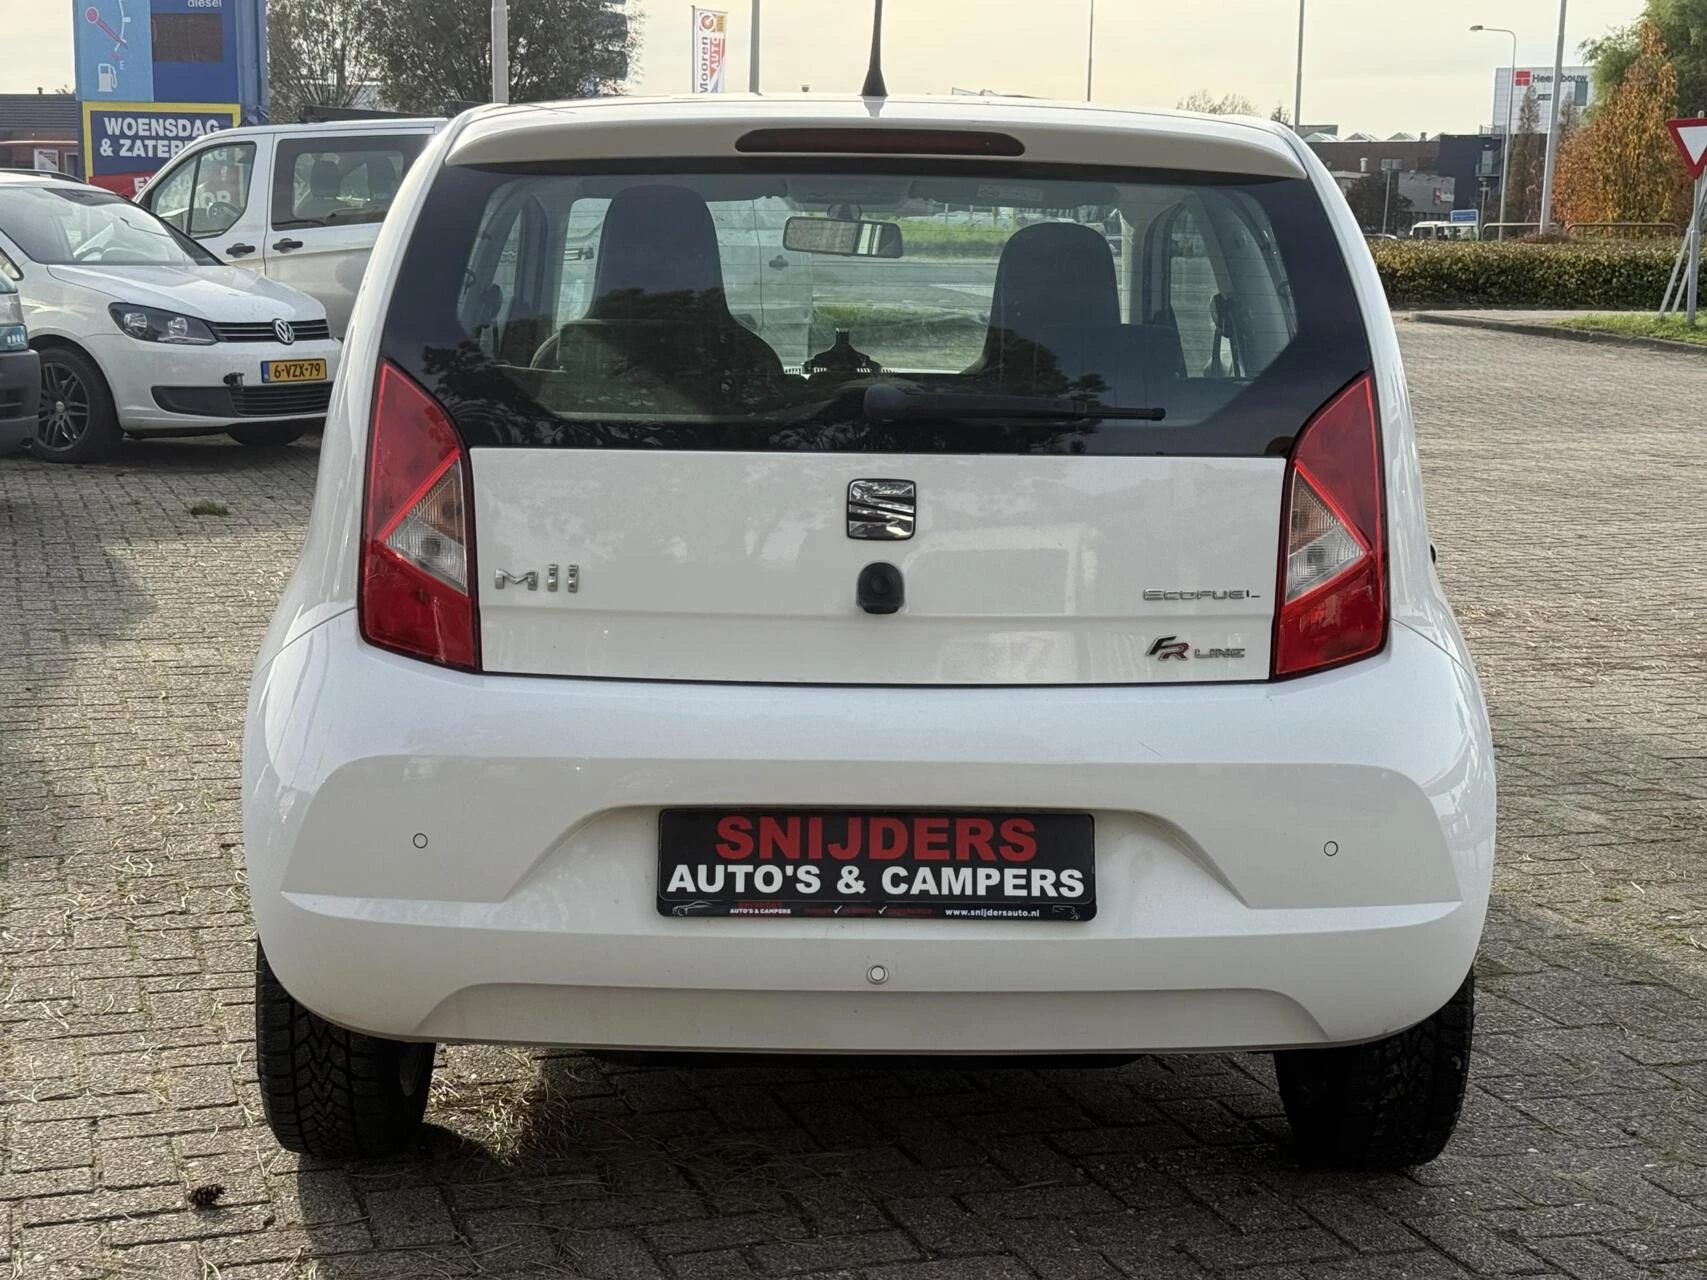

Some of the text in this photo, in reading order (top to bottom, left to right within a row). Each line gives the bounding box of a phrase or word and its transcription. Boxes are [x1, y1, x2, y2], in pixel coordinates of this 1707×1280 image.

[1532, 73, 1588, 83] Heebouw
[103, 117, 220, 137] WOENSDAG
[99, 138, 114, 157] &
[274, 362, 321, 379] 6-VZX-79
[1194, 648, 1246, 659] LINE
[715, 816, 1038, 862] SNIJDERS
[667, 864, 1085, 898] AUTO'S & CAMPERS
[945, 908, 1040, 917] www.snijdersauto.nl
